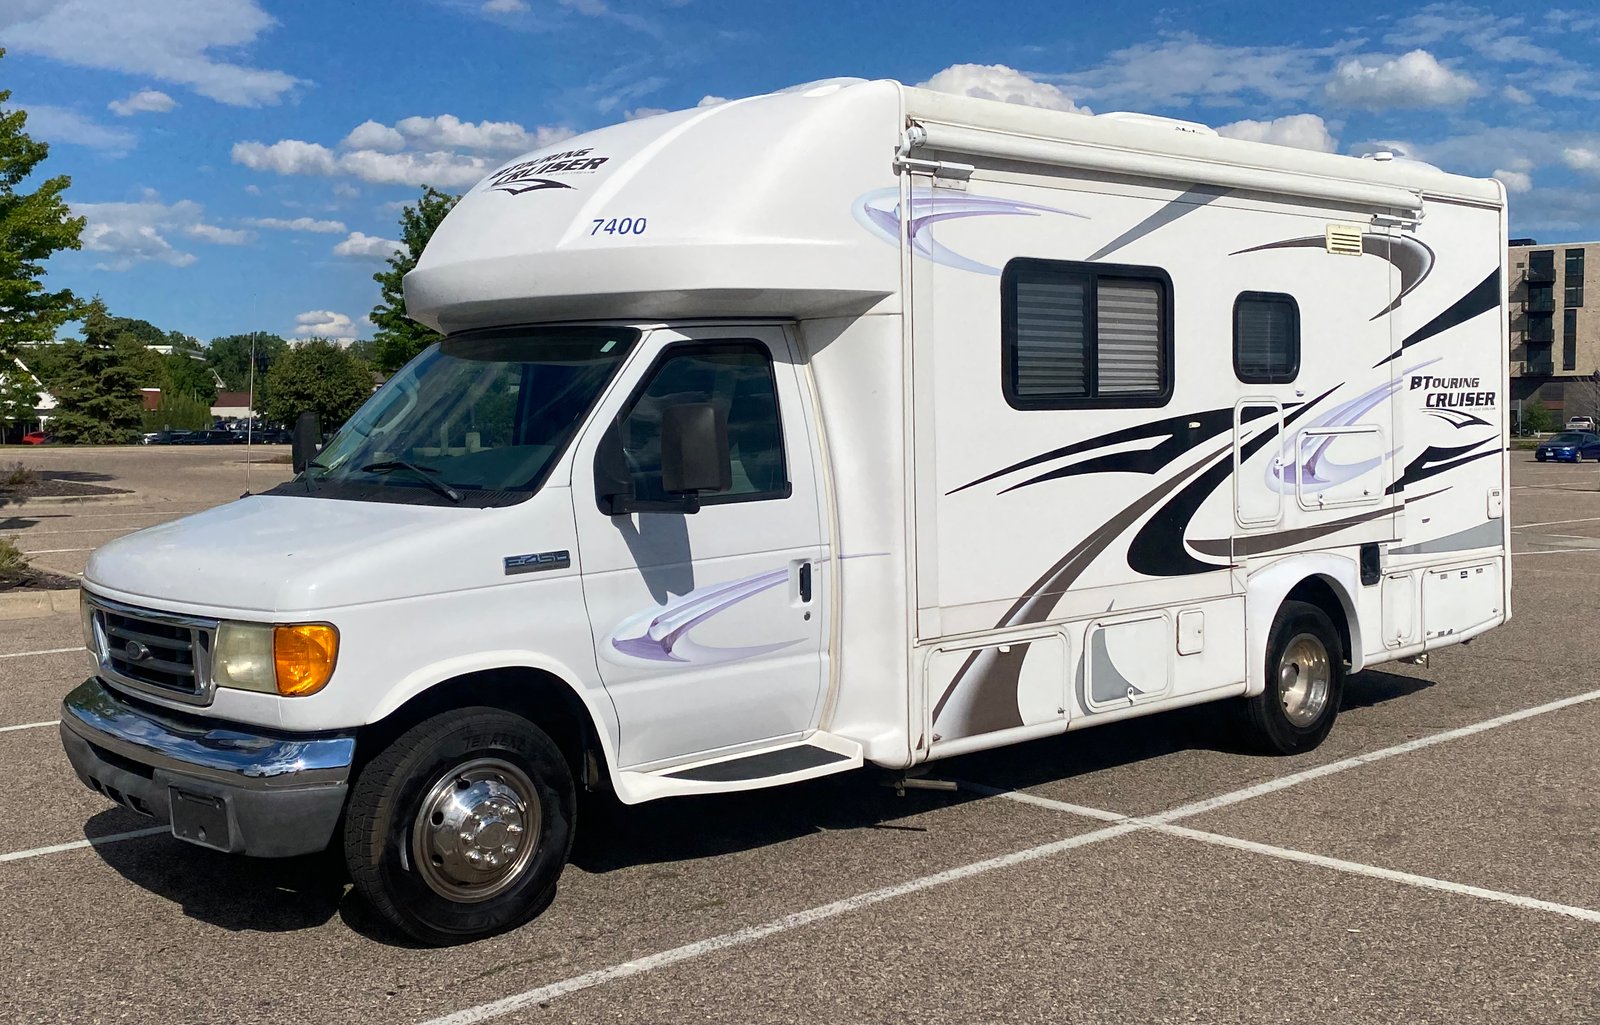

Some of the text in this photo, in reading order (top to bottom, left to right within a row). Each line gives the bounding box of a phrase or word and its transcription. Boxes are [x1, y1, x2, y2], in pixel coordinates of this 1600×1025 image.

[491, 157, 610, 187] CRUISER
[590, 217, 647, 236] 7400
[1409, 375, 1480, 391] BTOURING
[1425, 391, 1496, 408] CRUISER
